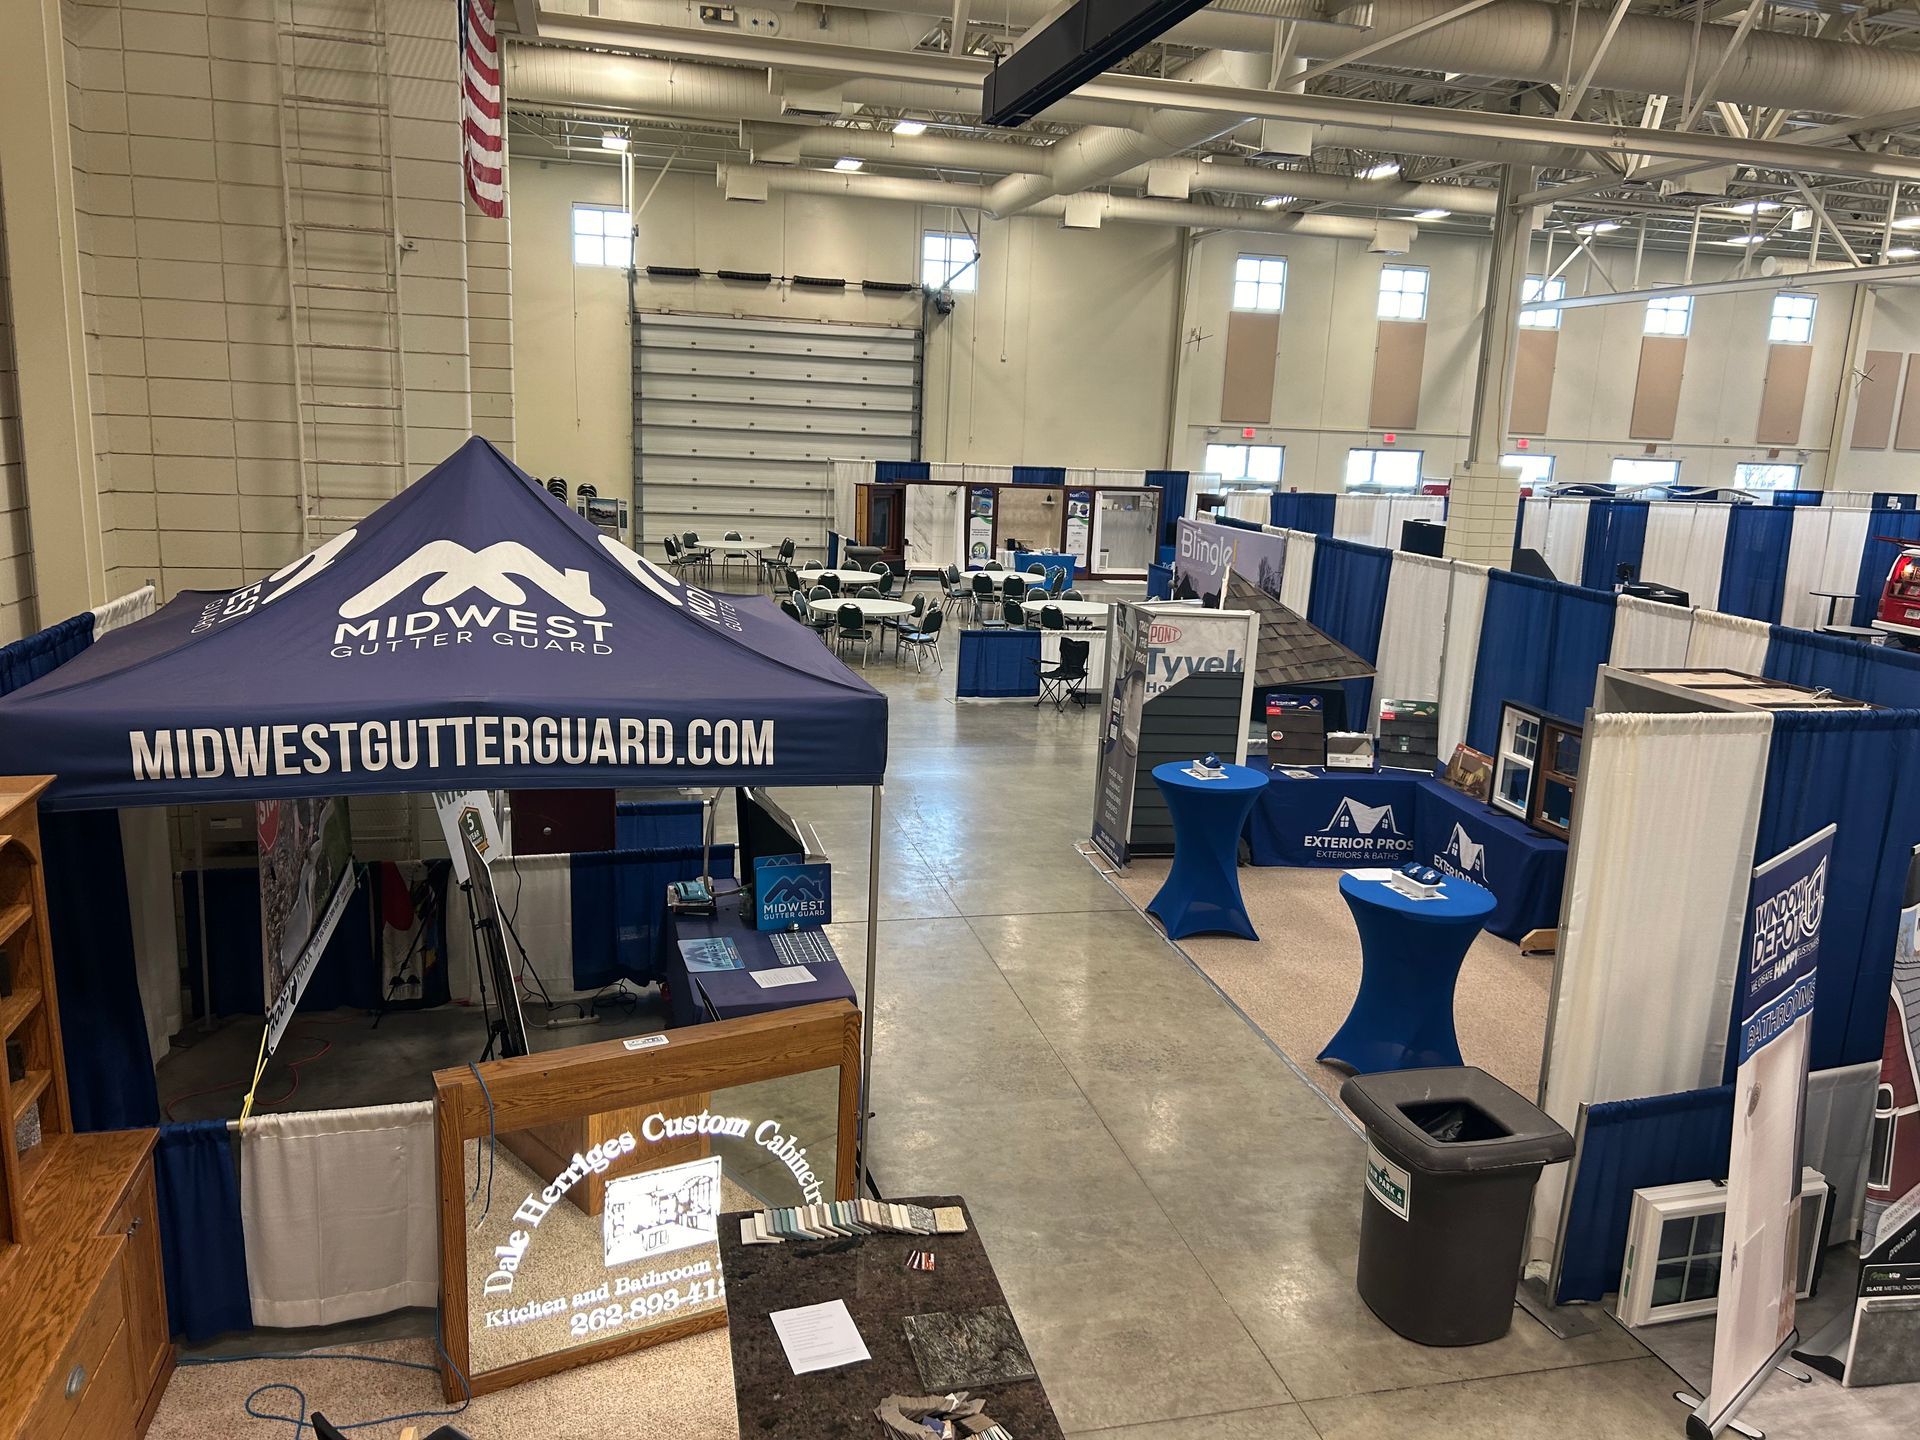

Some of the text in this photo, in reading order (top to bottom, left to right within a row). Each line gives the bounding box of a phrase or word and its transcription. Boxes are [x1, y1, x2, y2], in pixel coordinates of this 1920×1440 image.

[218, 580, 263, 623] EST
[686, 584, 720, 624] MID
[718, 599, 743, 632] GUTTE
[334, 605, 613, 644] MIDWEST
[331, 630, 613, 659] GUTTER GUARD
[1147, 648, 1243, 682] Tyvek
[129, 715, 776, 781] MIDWESTGUTTERGUARD.COM
[466, 812, 475, 831] 5
[1304, 835, 1414, 851] EXTERIOR PROS
[1316, 850, 1399, 860] EXTERIORS & BATHS
[763, 900, 825, 914] MIDWEST
[764, 909, 825, 920] GUTTER GUARD
[1756, 876, 1808, 932] WINDOW
[1751, 912, 1802, 974] DEPOT
[1774, 949, 1798, 980] HAPPY
[1747, 977, 1816, 1053] BATHROOMS
[1379, 1176, 1395, 1195] PARK
[483, 1109, 824, 1297] Dale Herriges Custom Cabinetr
[484, 1294, 567, 1329] Kitchen
[572, 1282, 610, 1306] and
[615, 1260, 712, 1295] Bathroom
